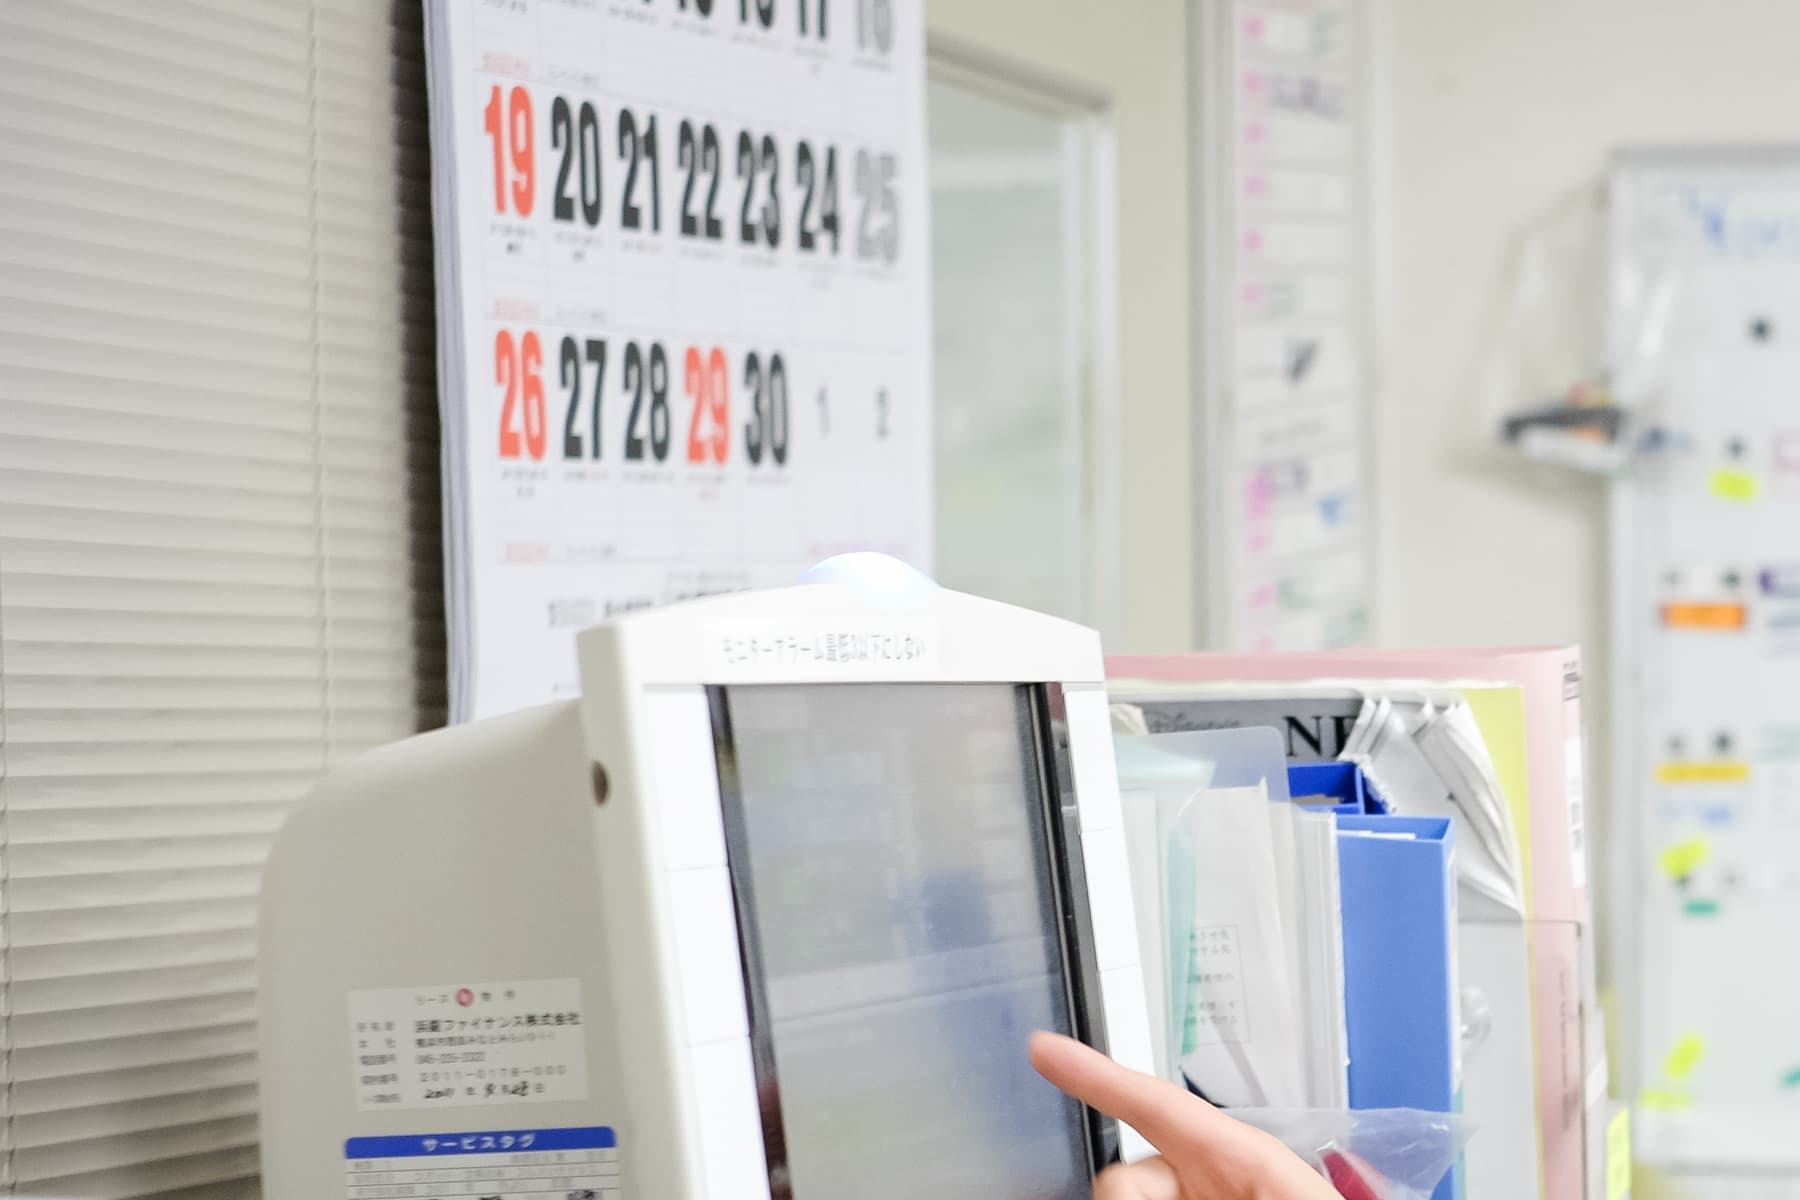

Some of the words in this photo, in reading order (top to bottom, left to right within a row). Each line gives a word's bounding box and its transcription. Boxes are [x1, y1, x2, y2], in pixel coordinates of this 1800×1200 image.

[484, 85, 537, 219] 19
[551, 96, 602, 228] 20
[618, 108, 661, 232] 21
[678, 119, 723, 240] 22
[737, 130, 781, 249] 23
[796, 140, 839, 255] 24
[854, 146, 900, 265] 25
[495, 329, 547, 461] 26
[560, 336, 607, 460] 27
[623, 341, 670, 463] 28
[684, 346, 730, 466] 29
[745, 351, 789, 467] 30
[875, 385, 891, 438] 2
[421, 1133, 537, 1153] サービスタグ
